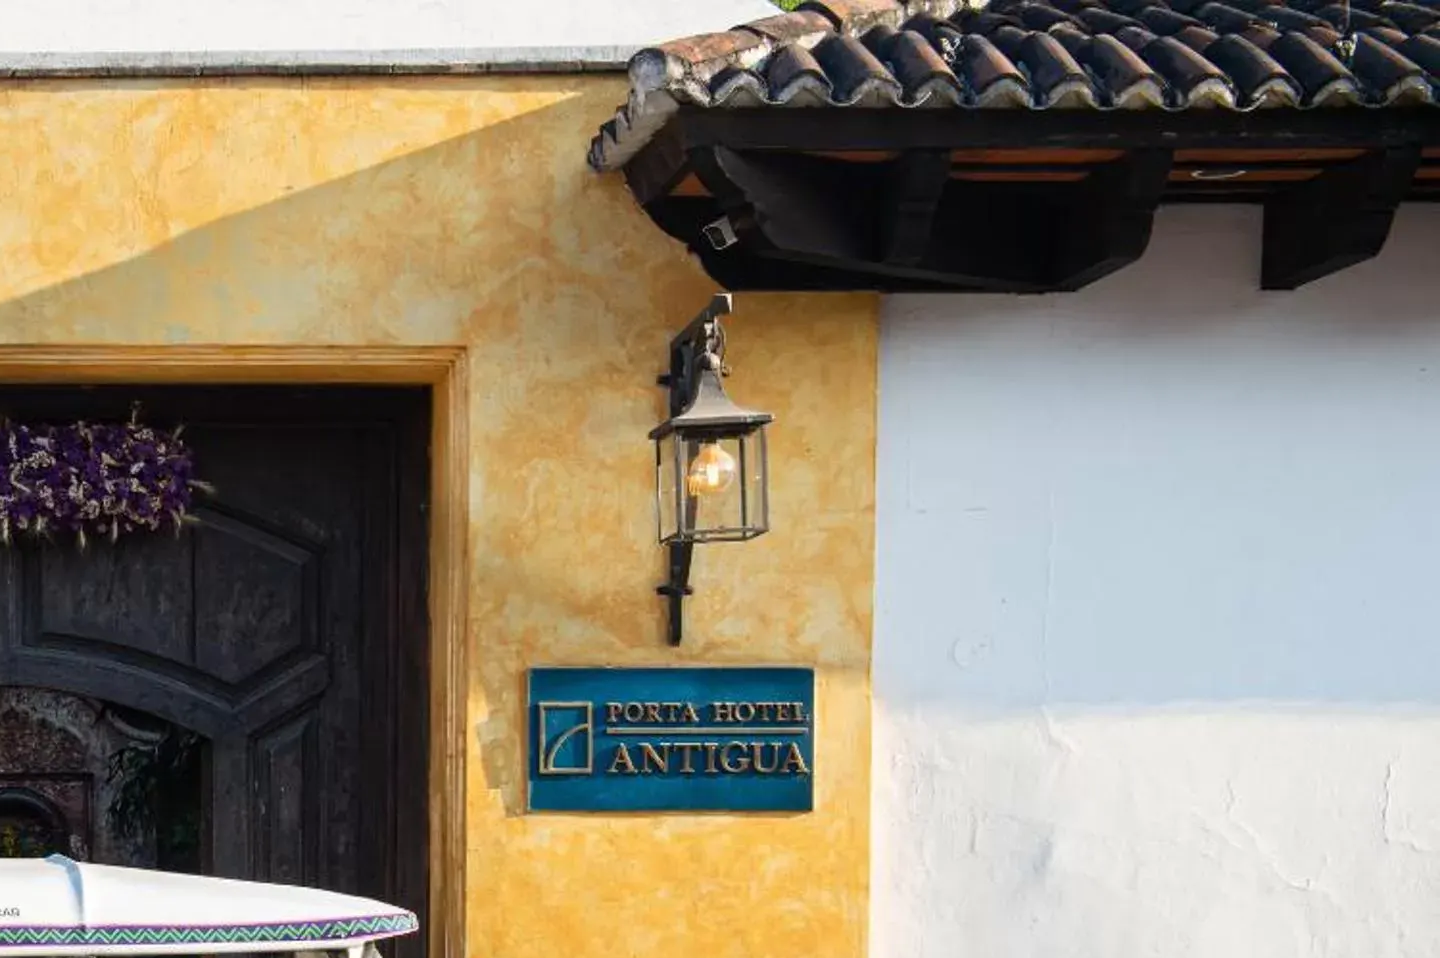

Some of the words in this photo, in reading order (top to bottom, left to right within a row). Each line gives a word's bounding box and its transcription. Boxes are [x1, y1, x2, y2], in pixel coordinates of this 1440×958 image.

[606, 701, 699, 723] PORTA
[713, 701, 808, 723] HOTEL
[609, 741, 810, 774] ANTIGUA
